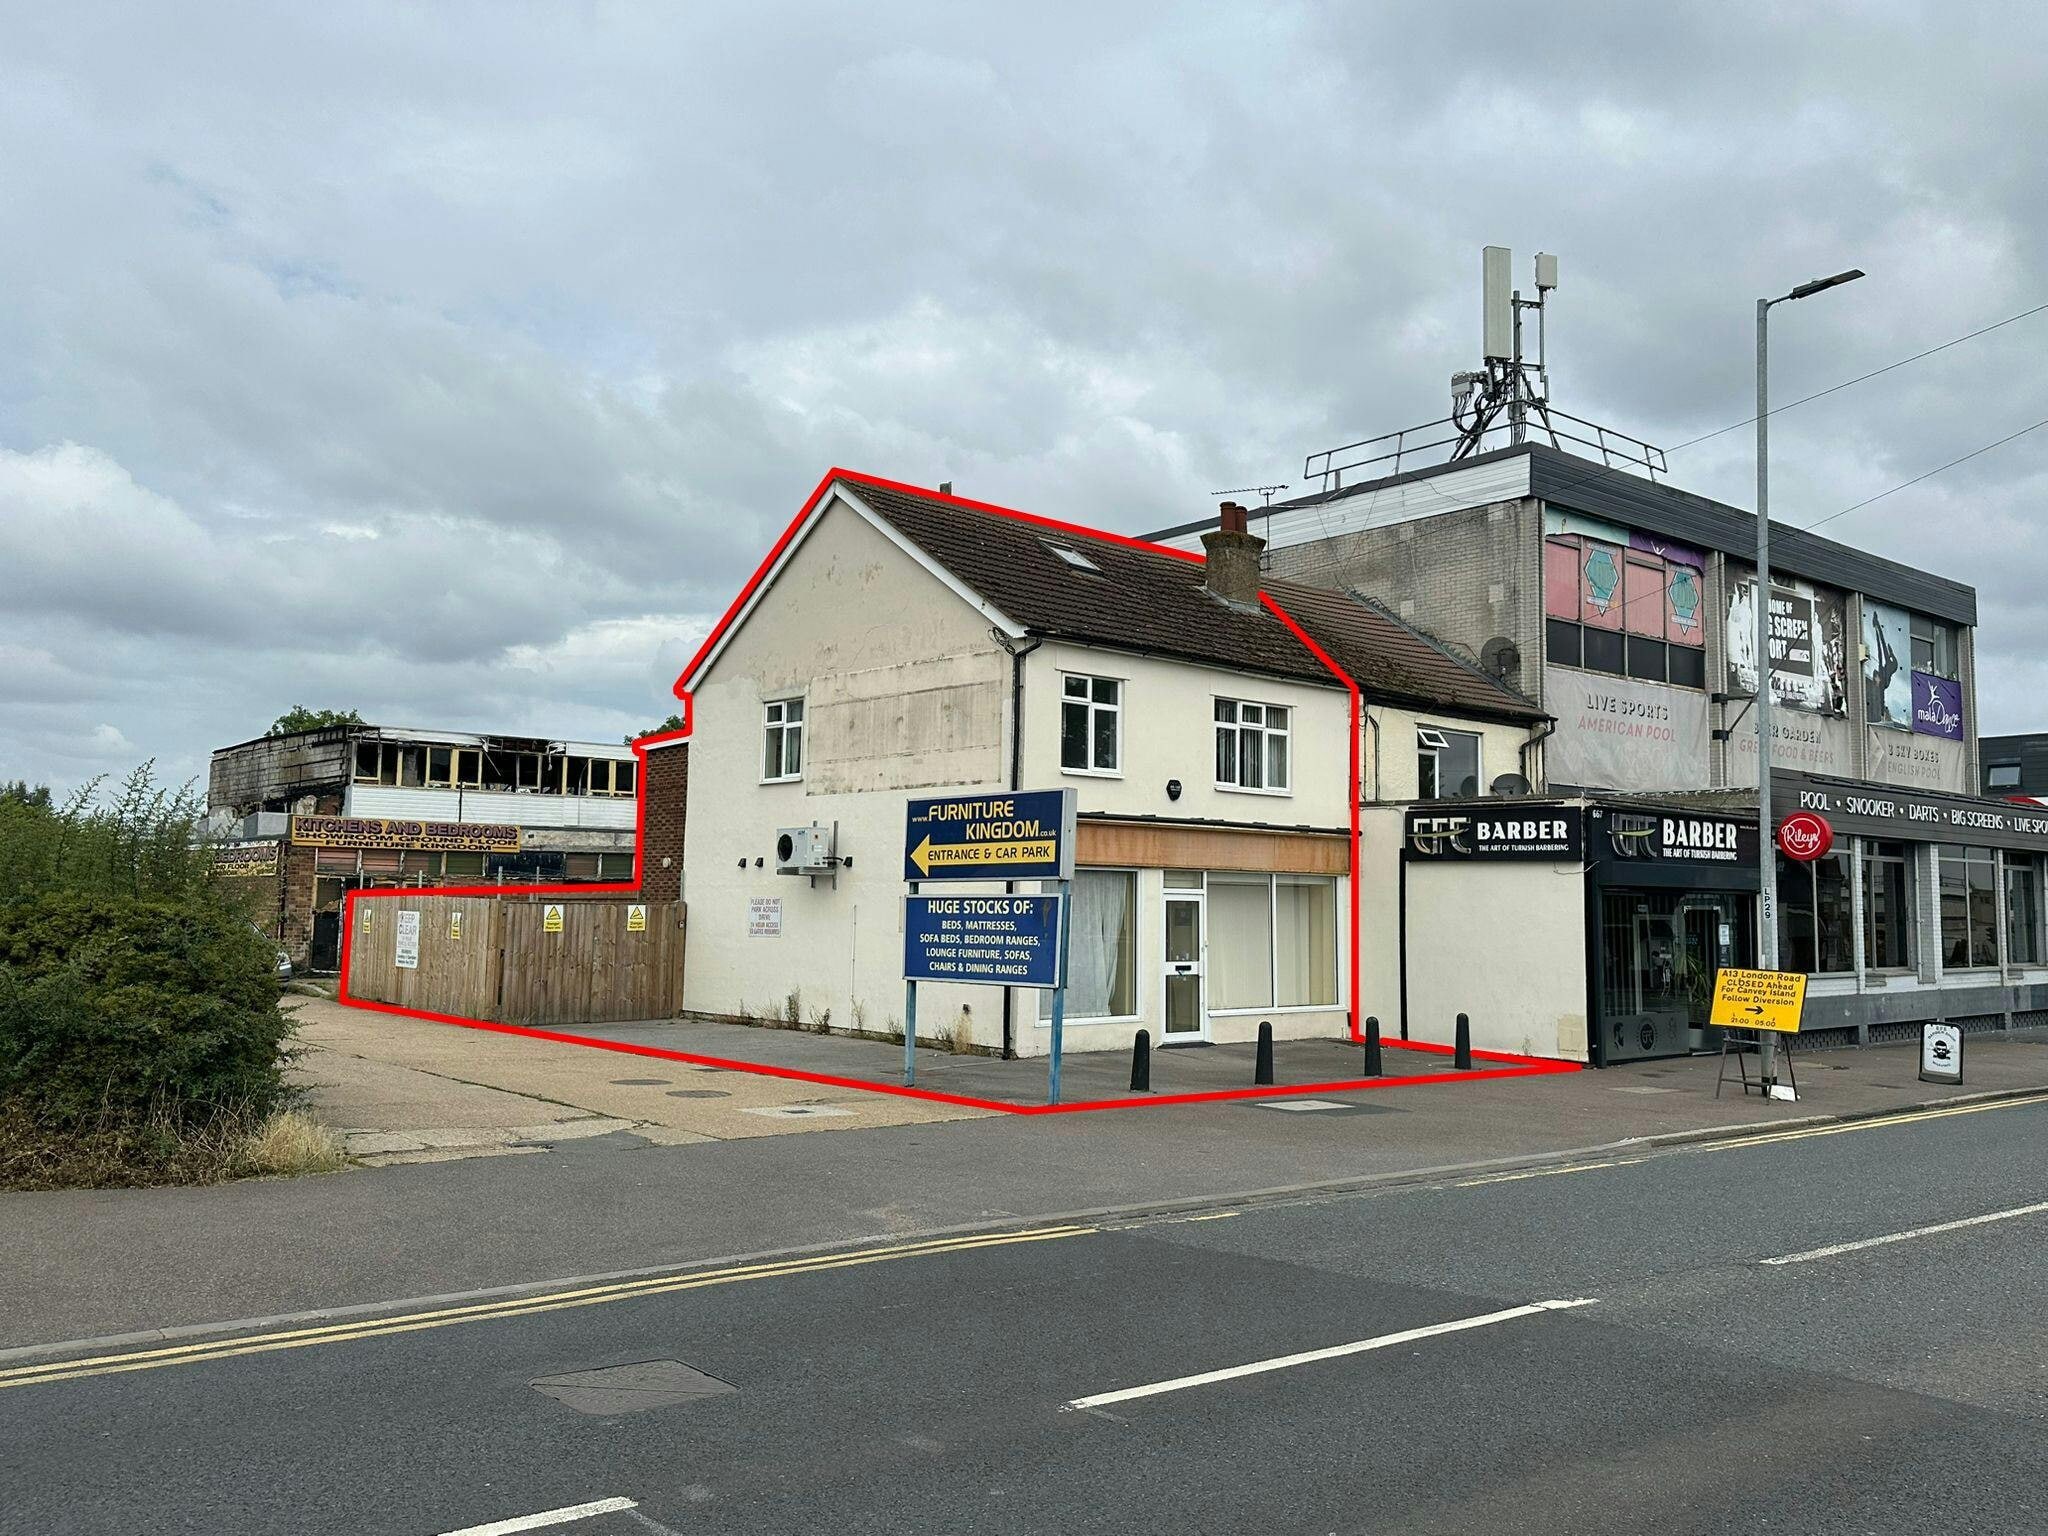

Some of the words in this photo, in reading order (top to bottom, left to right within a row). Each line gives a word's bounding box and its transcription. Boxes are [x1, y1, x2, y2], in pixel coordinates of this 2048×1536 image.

[1769, 638, 1787, 660] ORT
[1587, 692, 1616, 713] LIVE
[1621, 697, 1668, 720] SPORTS
[1578, 715, 1643, 737] AMERICAN
[1646, 725, 1676, 741] POOL
[1782, 726, 1822, 743] GARDEN
[1740, 738, 1760, 754] GRE
[1772, 744, 1798, 759] FOOD
[1809, 749, 1834, 763] BEERS
[1592, 809, 1603, 819] 667
[1800, 791, 1831, 811] POOL
[1847, 796, 1895, 818] SNOOKER
[1909, 804, 1939, 823] DARTS
[1951, 809, 1966, 826] BIG
[1967, 811, 2003, 830] SCREENS
[2014, 818, 2031, 833] LIVE
[295, 817, 383, 834] KITCHENS
[385, 821, 422, 836] AND
[425, 823, 518, 839] BEDROOMS
[1477, 820, 1568, 840] BARBER
[1663, 818, 1737, 849] BARBER
[295, 832, 394, 842] SHOWROOM
[398, 836, 465, 844] GROUND
[1781, 825, 1819, 849] Rileys
[325, 840, 415, 849] FURNITURE
[420, 842, 492, 851] KINGDOM
[1535, 843, 1569, 851] BARBERING
[928, 848, 980, 861] ENTRANCE
[984, 848, 992, 859] &
[996, 847, 1017, 858] CAR
[1022, 846, 1051, 858] PARK
[1663, 848, 1672, 857] THE
[1673, 848, 1682, 857] ART
[1683, 848, 1691, 858] OF
[1691, 849, 1711, 859] TURKISH
[1712, 850, 1738, 860] BARBERING
[928, 900, 959, 914] HUGE
[963, 900, 1010, 914] STOCKS
[1013, 901, 1033, 914] OF:
[942, 920, 963, 930] BEDS,
[966, 921, 1017, 931] MATTRESSES,
[920, 933, 939, 943] SOFA
[941, 934, 962, 944] BEDS,
[964, 935, 1004, 945] BEDROOM
[1006, 936, 1040, 947] RANGES,
[926, 948, 956, 957] LOUNGE
[958, 948, 1001, 960] FURNITURE,
[1004, 950, 1032, 961] SOFAS,
[929, 961, 956, 972] CHAIRS
[958, 963, 963, 972] &
[966, 963, 994, 973] DINING
[996, 965, 1028, 975] RANGES
[1722, 969, 1738, 977] A13
[1742, 971, 1773, 980] London
[1777, 973, 1800, 982] Road
[1727, 979, 1763, 987] CLOSED
[1766, 981, 1794, 990] Ahead
[1737, 987, 1767, 996] Canvey
[1722, 994, 1750, 1002] Follow
[1753, 996, 1794, 1005] Diversion
